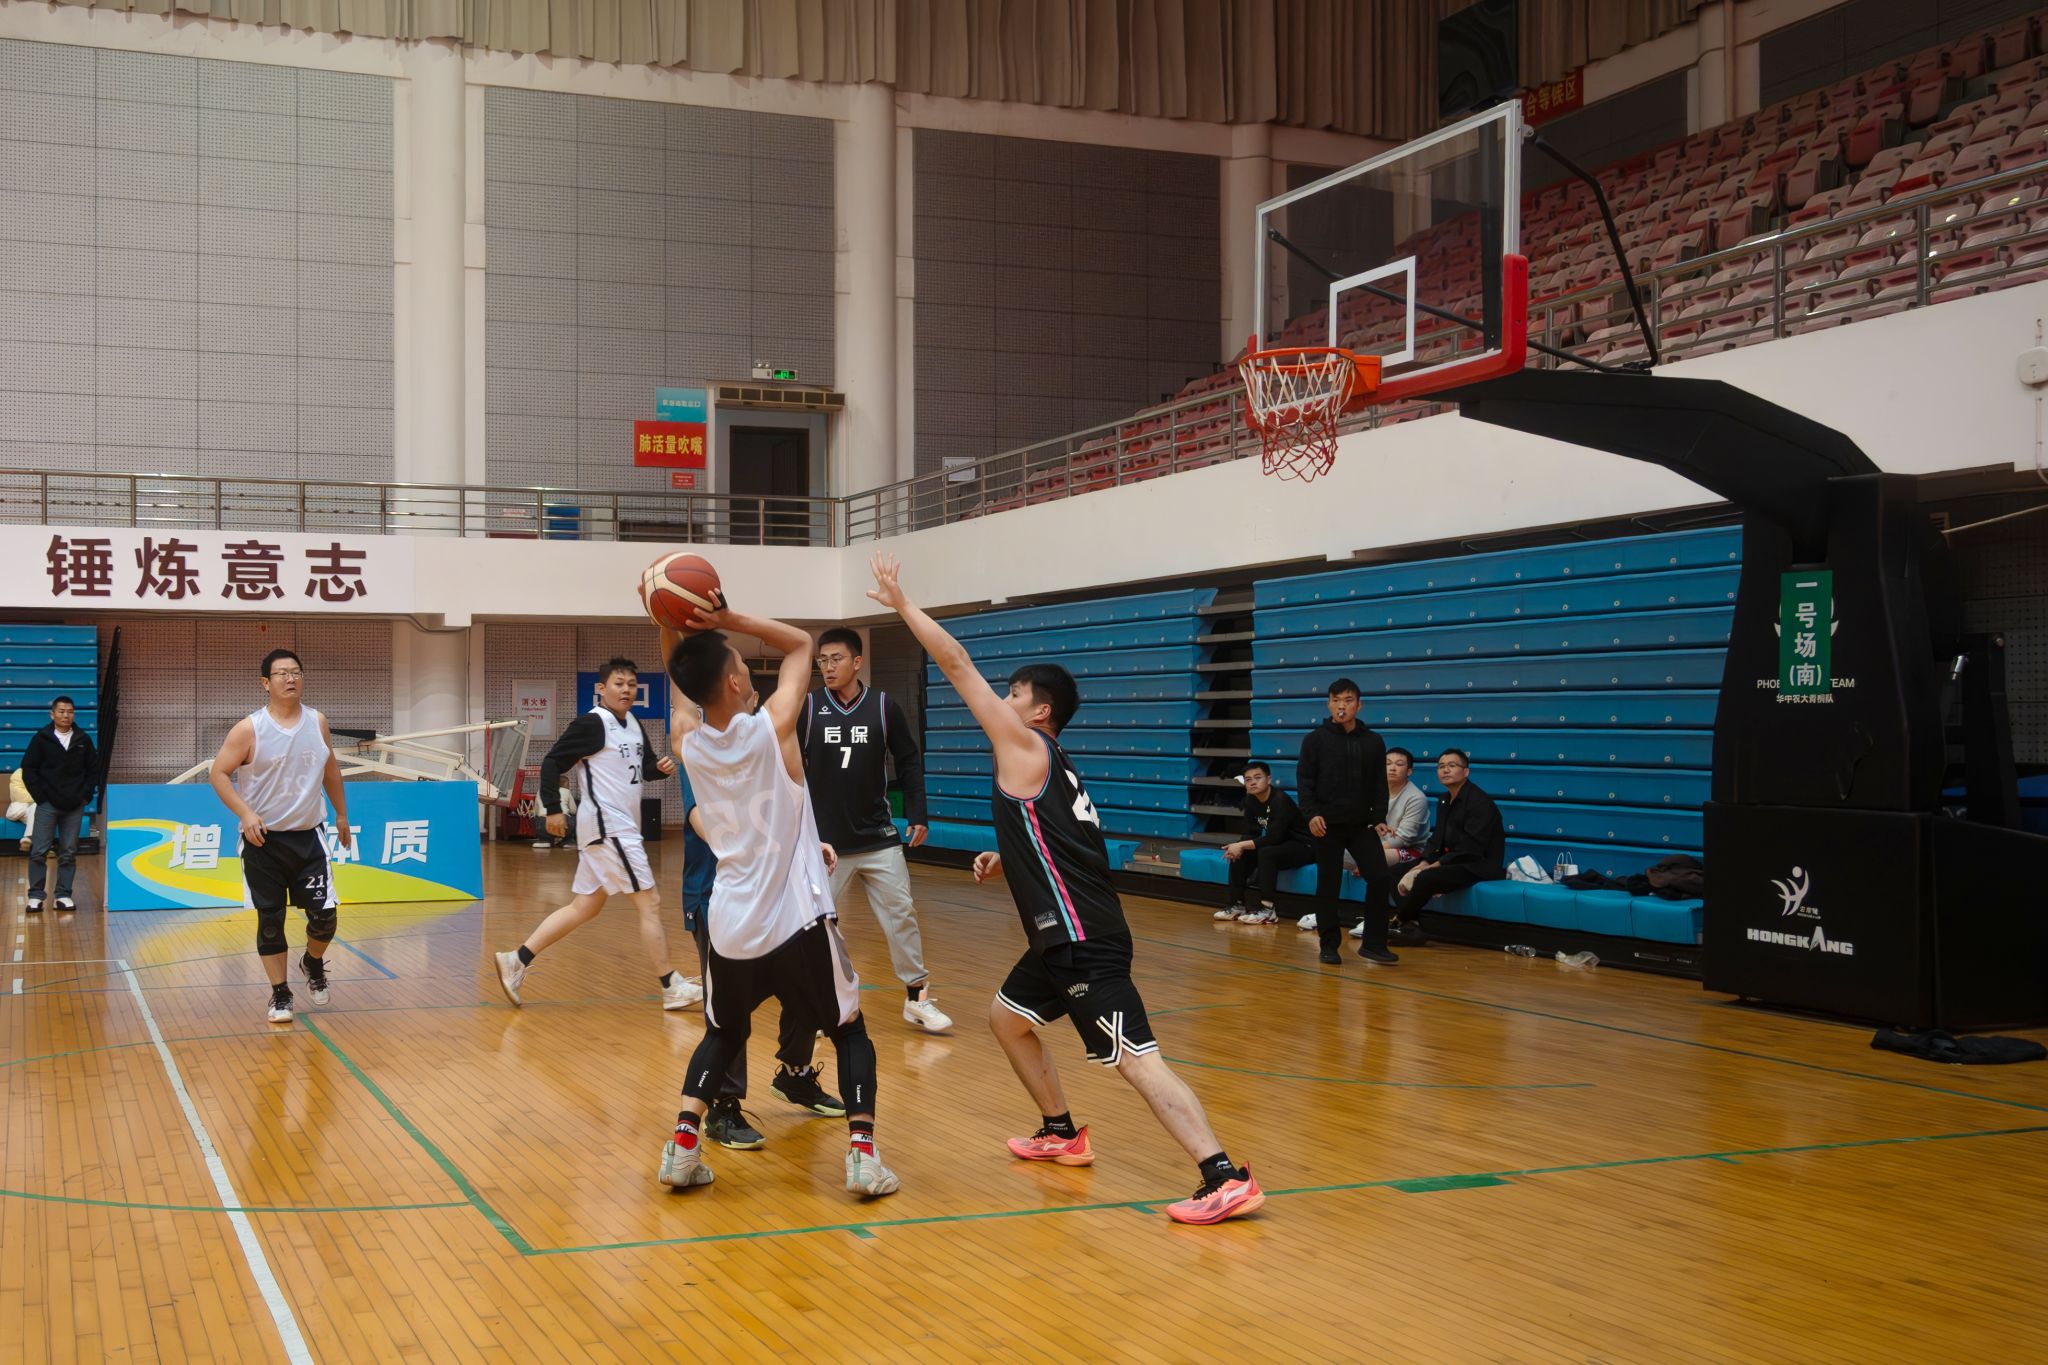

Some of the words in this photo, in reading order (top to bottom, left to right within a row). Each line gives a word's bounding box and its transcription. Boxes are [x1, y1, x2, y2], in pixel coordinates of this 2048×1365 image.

[639, 434, 703, 455] 肺活量吹嘴
[46, 534, 368, 602] 锤炼意志
[824, 726, 868, 743] 后保
[840, 747, 852, 769] 7
[168, 819, 430, 870] 增体质
[305, 874, 325, 889] 21
[1747, 925, 1853, 956] HONGKANG
